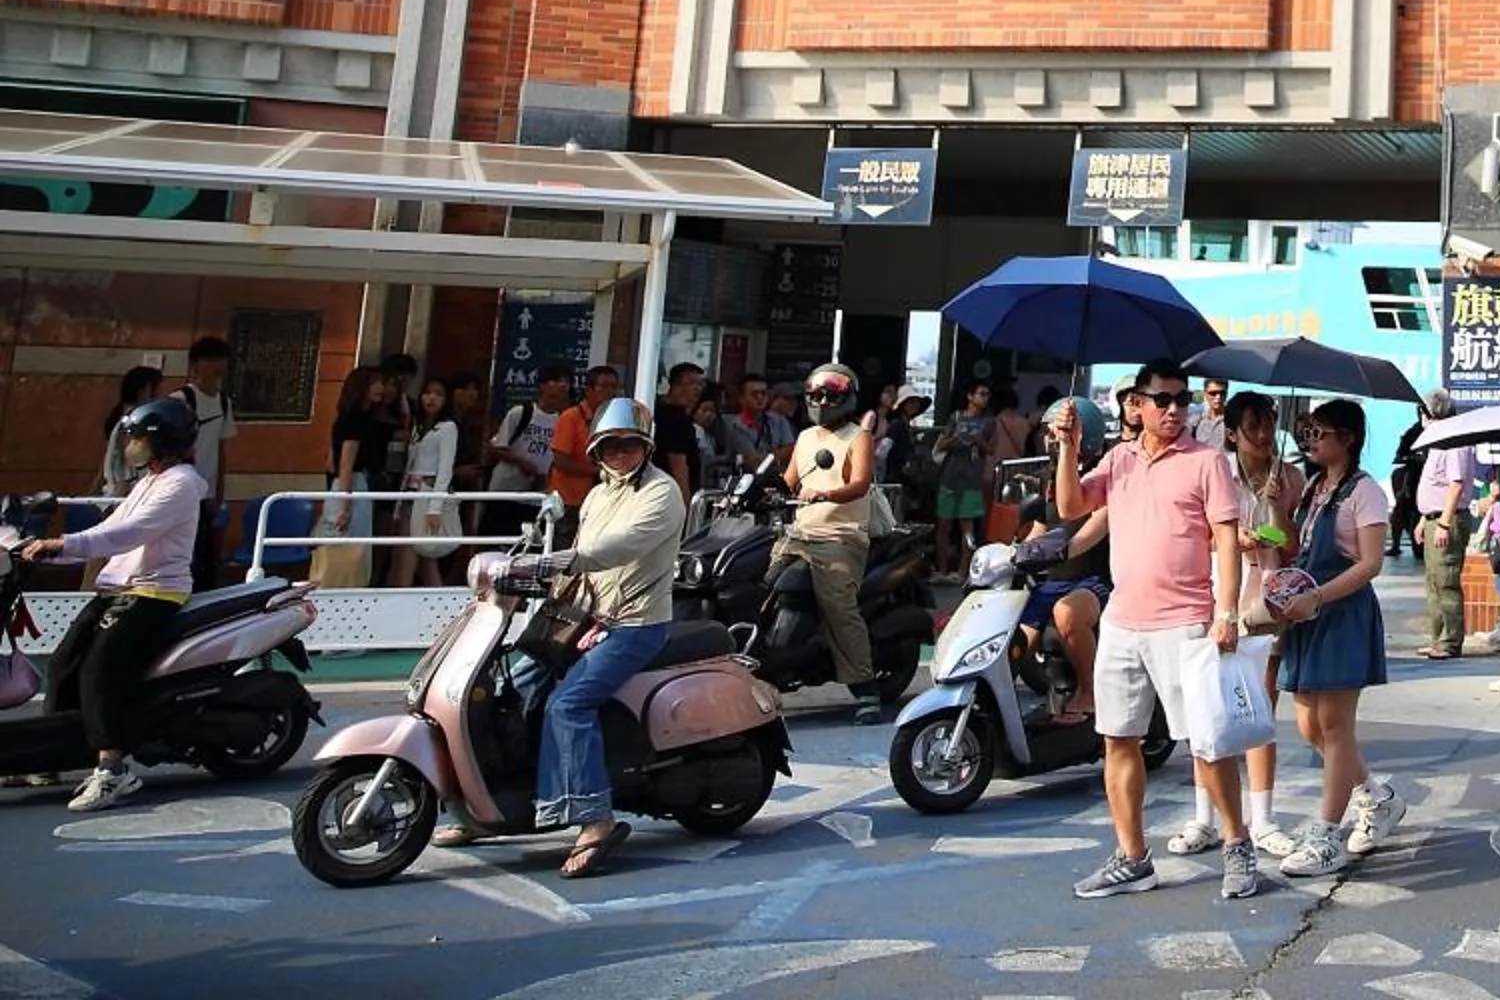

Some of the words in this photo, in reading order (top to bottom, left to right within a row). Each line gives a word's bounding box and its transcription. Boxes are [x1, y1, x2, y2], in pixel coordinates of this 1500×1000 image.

[839, 160, 921, 184] 一般民眾
[1088, 153, 1171, 176] 旗津居民
[1086, 177, 1169, 199] 專用通道
